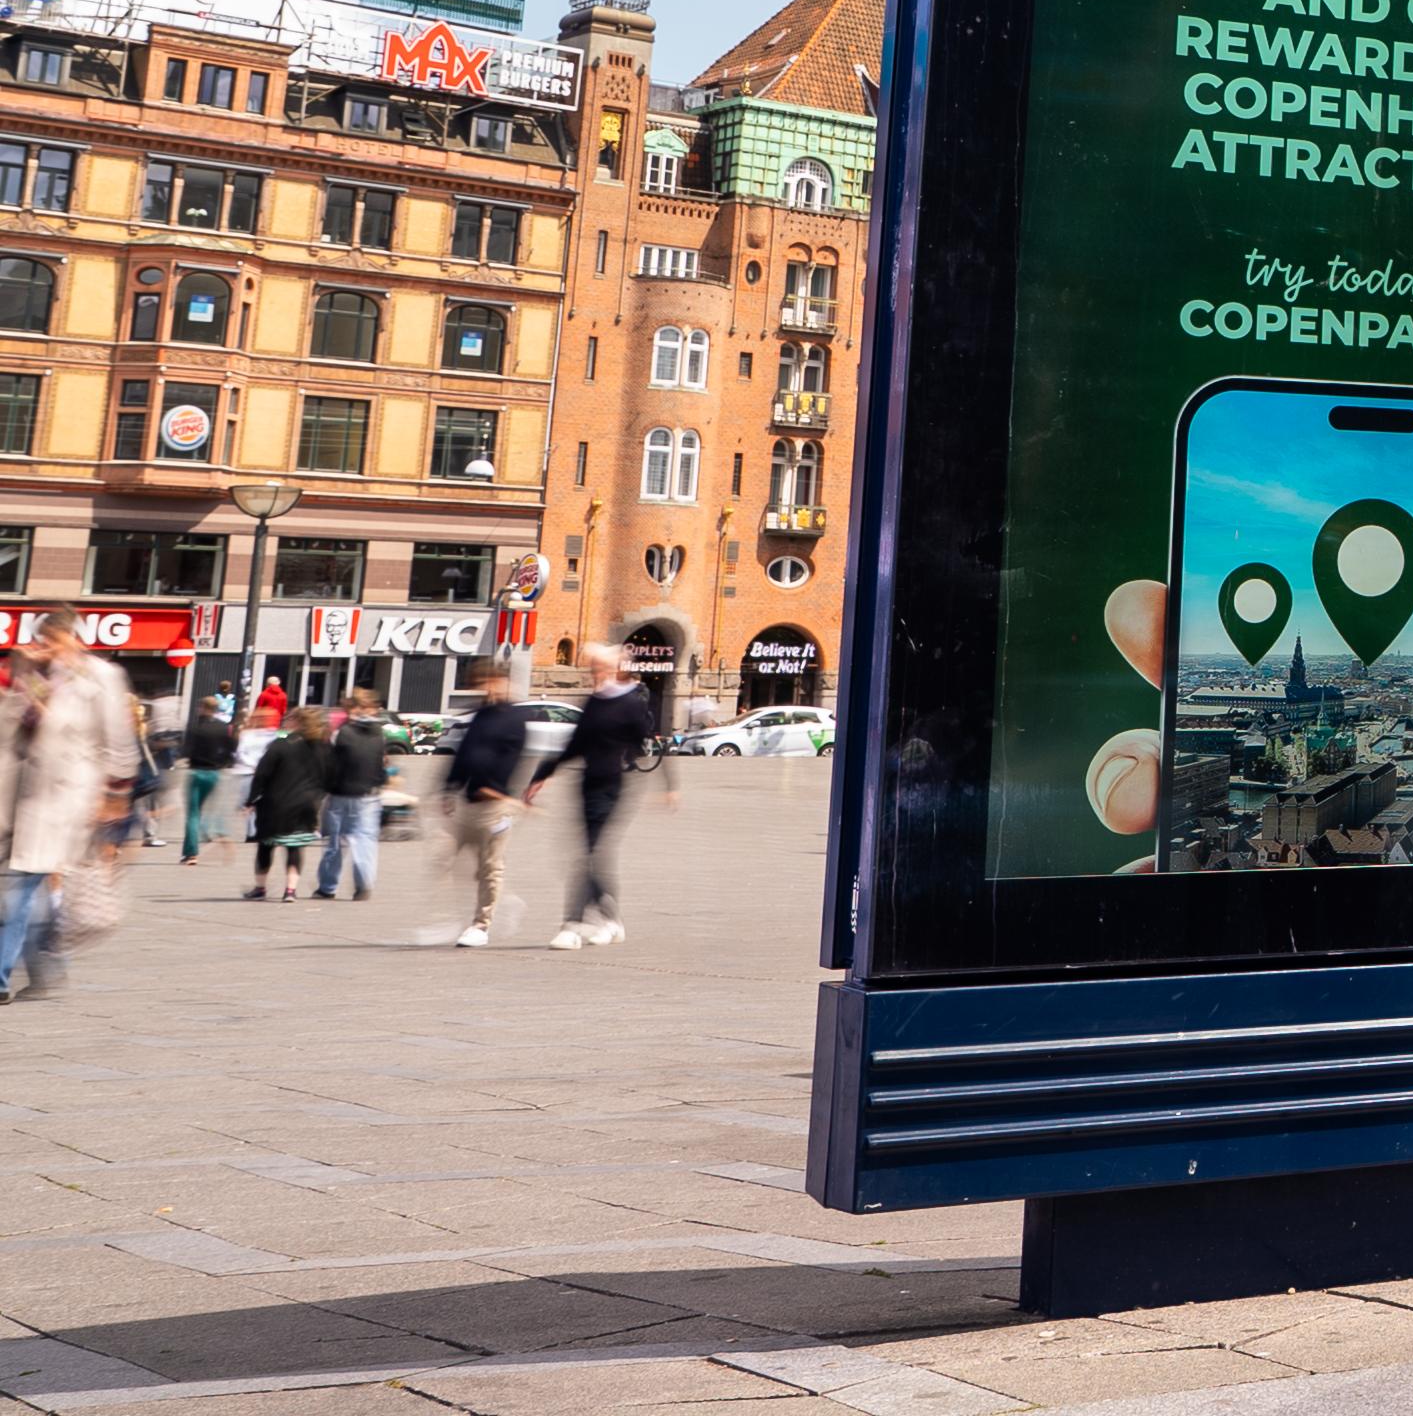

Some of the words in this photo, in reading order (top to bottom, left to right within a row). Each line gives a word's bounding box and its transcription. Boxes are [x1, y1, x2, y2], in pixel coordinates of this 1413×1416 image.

[382, 20, 495, 97] MAX
[502, 50, 575, 78] PREMIUM
[500, 69, 571, 97] BURGERS
[336, 136, 402, 159] HOTEL
[1244, 247, 1314, 303] try
[171, 423, 204, 438] KING
[17, 612, 132, 646] KNG
[369, 616, 484, 654] KFC
[750, 642, 800, 658] Believe
[801, 642, 815, 659] It
[619, 661, 674, 673] Museum
[759, 662, 775, 674] or
[776, 659, 808, 674] Not!
